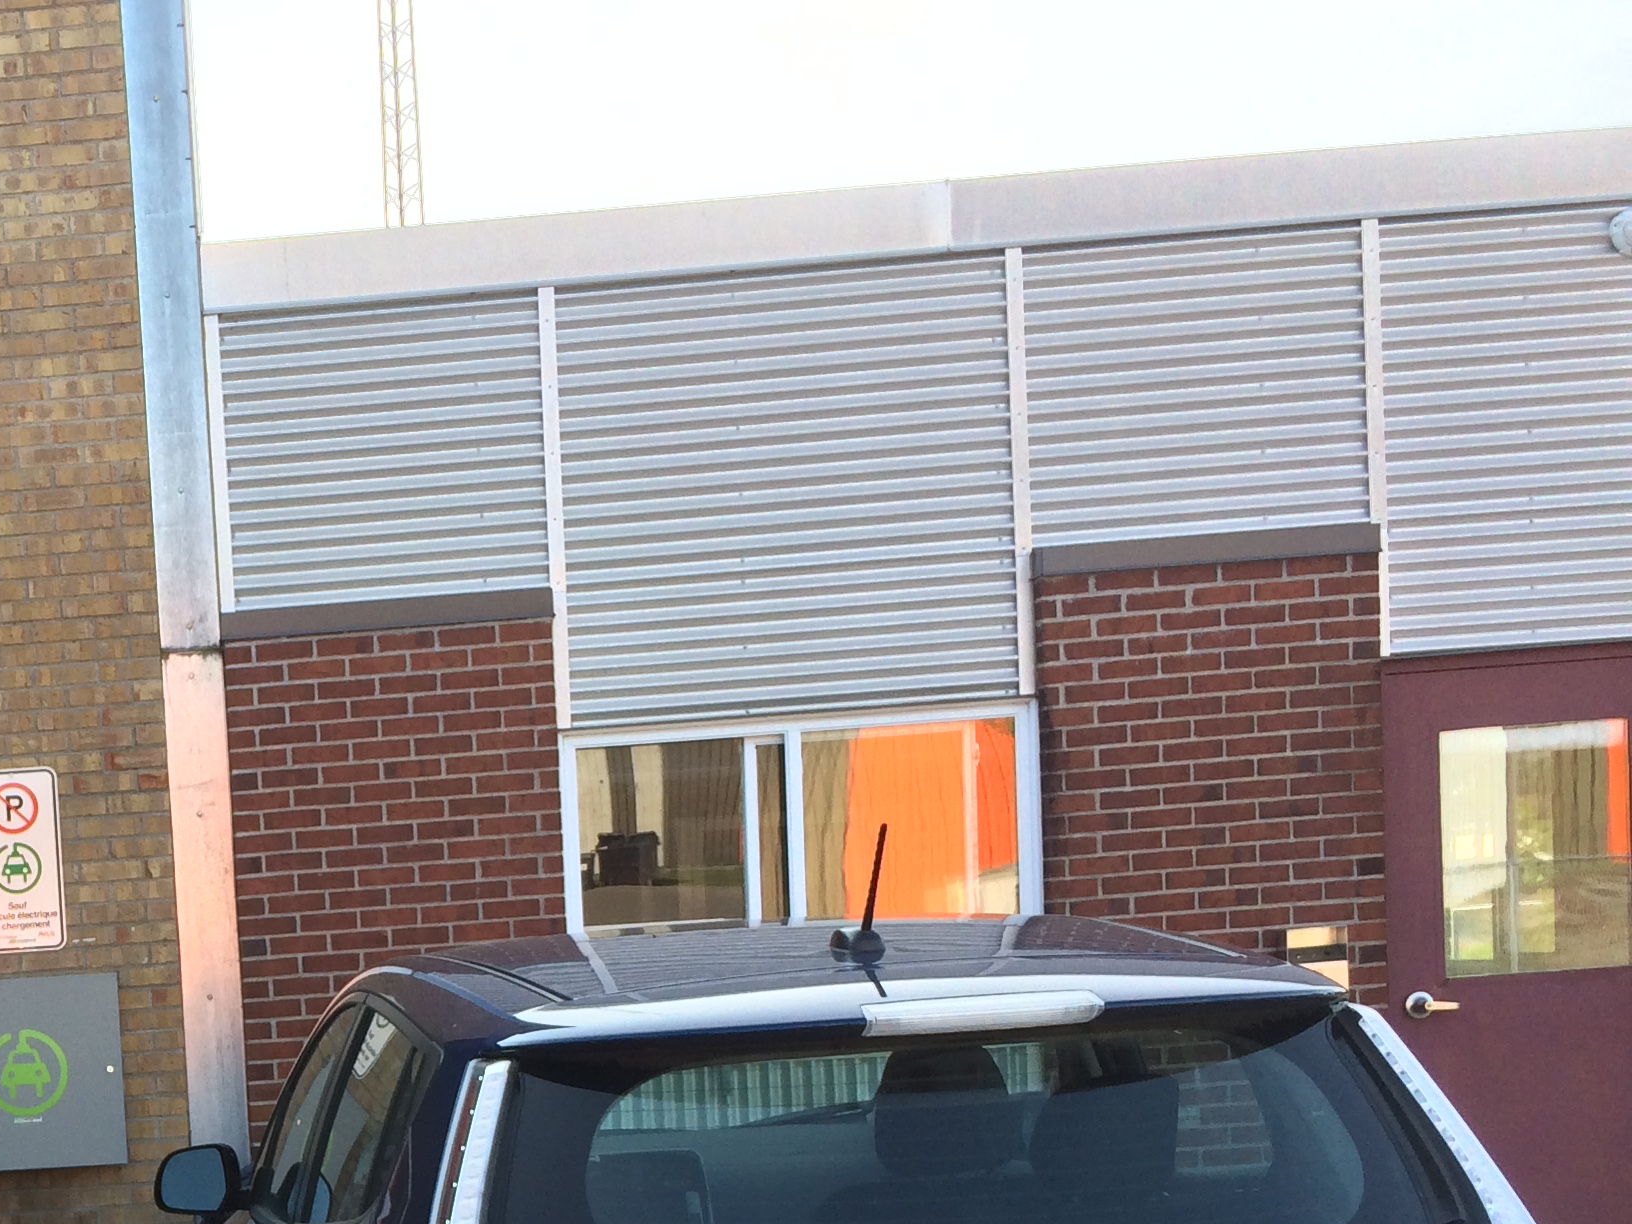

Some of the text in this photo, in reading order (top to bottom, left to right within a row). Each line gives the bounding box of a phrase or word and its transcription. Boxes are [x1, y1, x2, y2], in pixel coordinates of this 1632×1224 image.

[5, 795, 24, 822] P
[8, 901, 28, 910] Sauf
[17, 910, 58, 919] électrique
[1, 920, 51, 931] chargement
